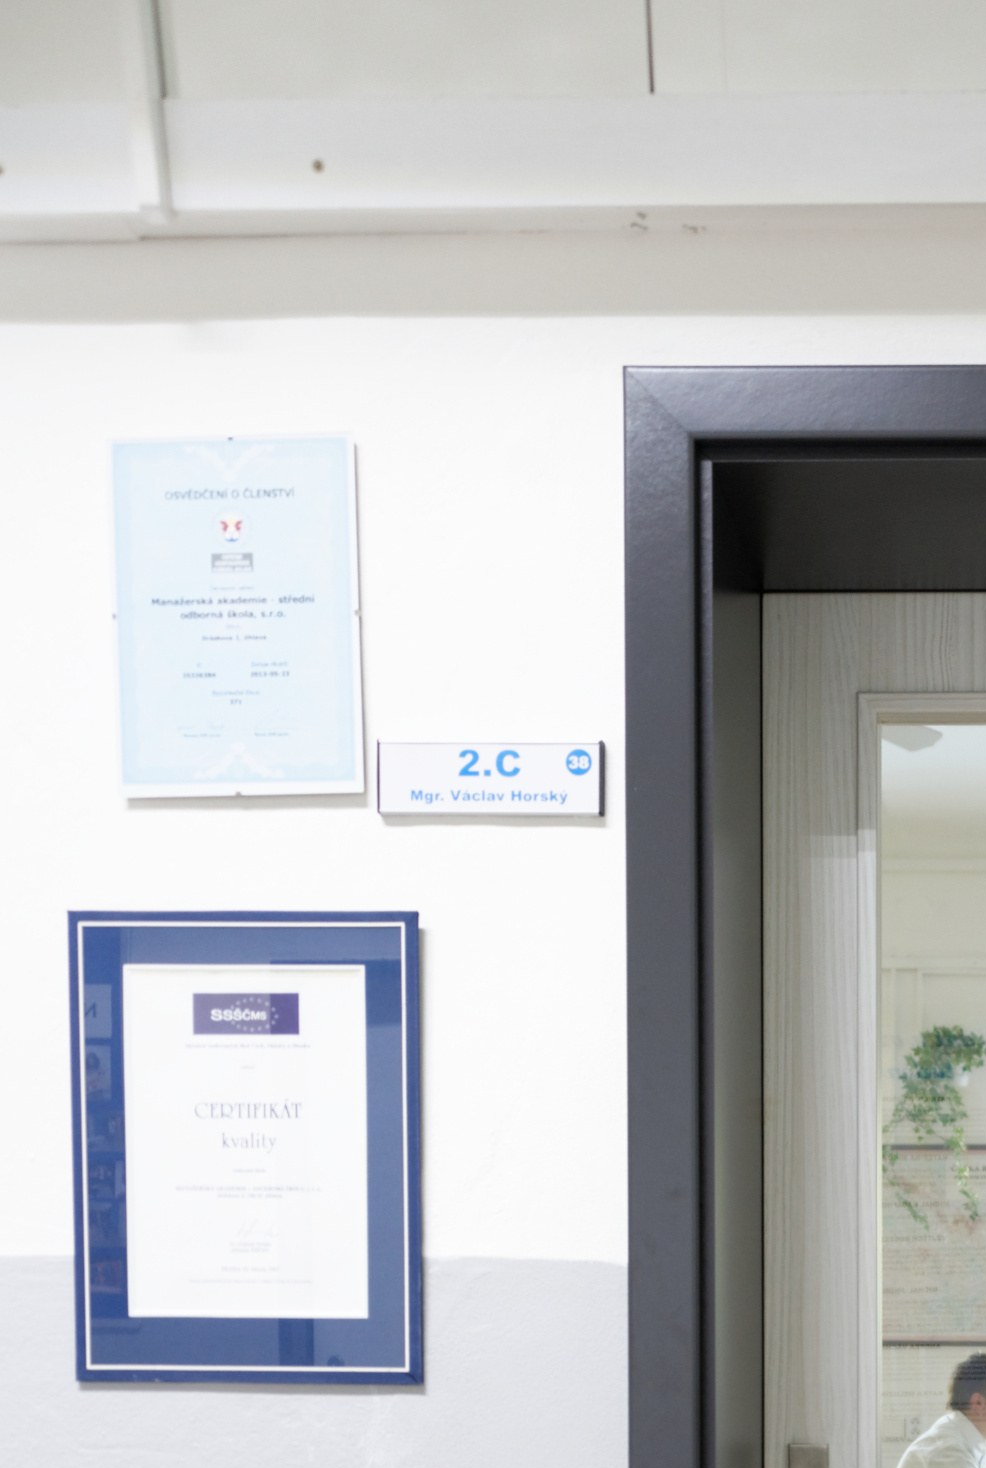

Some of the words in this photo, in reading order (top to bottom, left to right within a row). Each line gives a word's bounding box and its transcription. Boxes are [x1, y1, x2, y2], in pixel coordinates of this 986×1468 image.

[165, 488, 228, 501] OSVĚDČENÍ
[231, 489, 240, 499] O
[243, 486, 296, 499] ČLENSTVÍ
[151, 595, 213, 607] Manažerská
[217, 595, 267, 606] akademie
[180, 610, 223, 620] odborná
[227, 609, 257, 620] škola,
[260, 610, 287, 619] s.r.o.
[458, 749, 521, 778] 2.C
[567, 755, 591, 770] 38
[410, 789, 445, 805] Mgr.
[450, 788, 505, 802] Václav
[511, 789, 569, 805] Horský
[210, 1007, 267, 1022] SSŠČMS
[193, 1098, 304, 1120] CERTIFIKÁT
[220, 1131, 278, 1154] kvality
